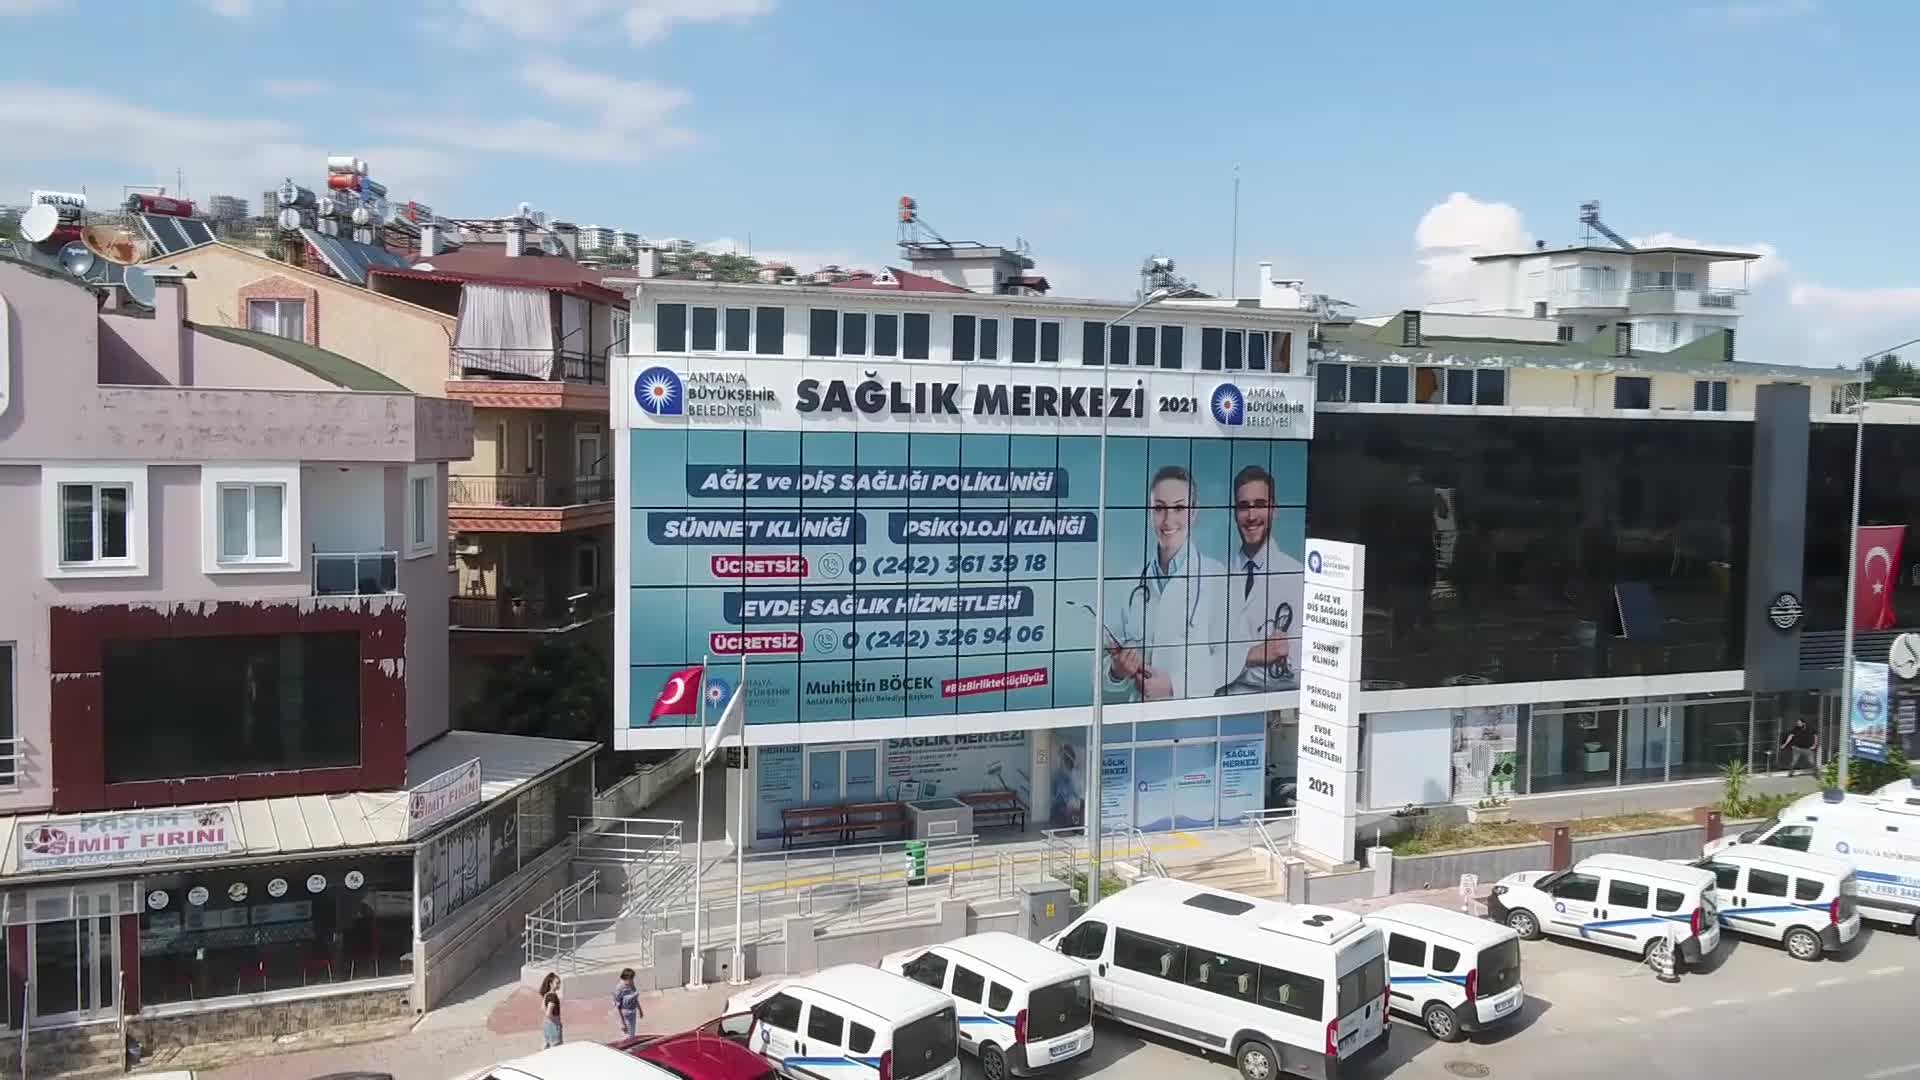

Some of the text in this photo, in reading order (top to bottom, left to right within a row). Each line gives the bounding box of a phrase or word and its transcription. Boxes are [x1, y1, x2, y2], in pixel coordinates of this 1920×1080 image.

[688, 372, 747, 385] ANTALYA
[688, 385, 775, 402] BÜYÜKŞEHİR
[795, 370, 1145, 418] SAĞLIK MERKEZİ
[1247, 388, 1286, 399] ANTALYA
[688, 402, 757, 417] BELEDİYESİ
[1159, 396, 1198, 414] 2021
[1247, 400, 1304, 414] BÜYÜKŞEHİR
[701, 469, 1053, 493] AĞIZ ve DİŞ SAĞLIĞI POLİKLİNİĞİ
[663, 515, 850, 538] SÜNNET KLİNİĞİ
[902, 515, 1087, 538] PSİKOLOJİ KLİNİĞİ
[715, 556, 804, 574] ÜCRETSİZ
[848, 554, 1047, 577] 0 (242) 361 39 18
[739, 591, 1022, 617] EVDE SAĞLIK HİZMETLERİ
[714, 634, 799, 651] ÜCRETSİZ
[842, 625, 1045, 651] 0 (242) 326 94 06
[806, 674, 934, 694] Muhittin BÖCEK
[1314, 724, 1332, 737] EVDE
[1310, 735, 1335, 750] SAĞLIK
[1223, 757, 1259, 768] MERKEZİ
[1225, 749, 1257, 758] SAĞLIK
[1308, 776, 1334, 797] 2021
[140, 829, 224, 848] FIRINI
